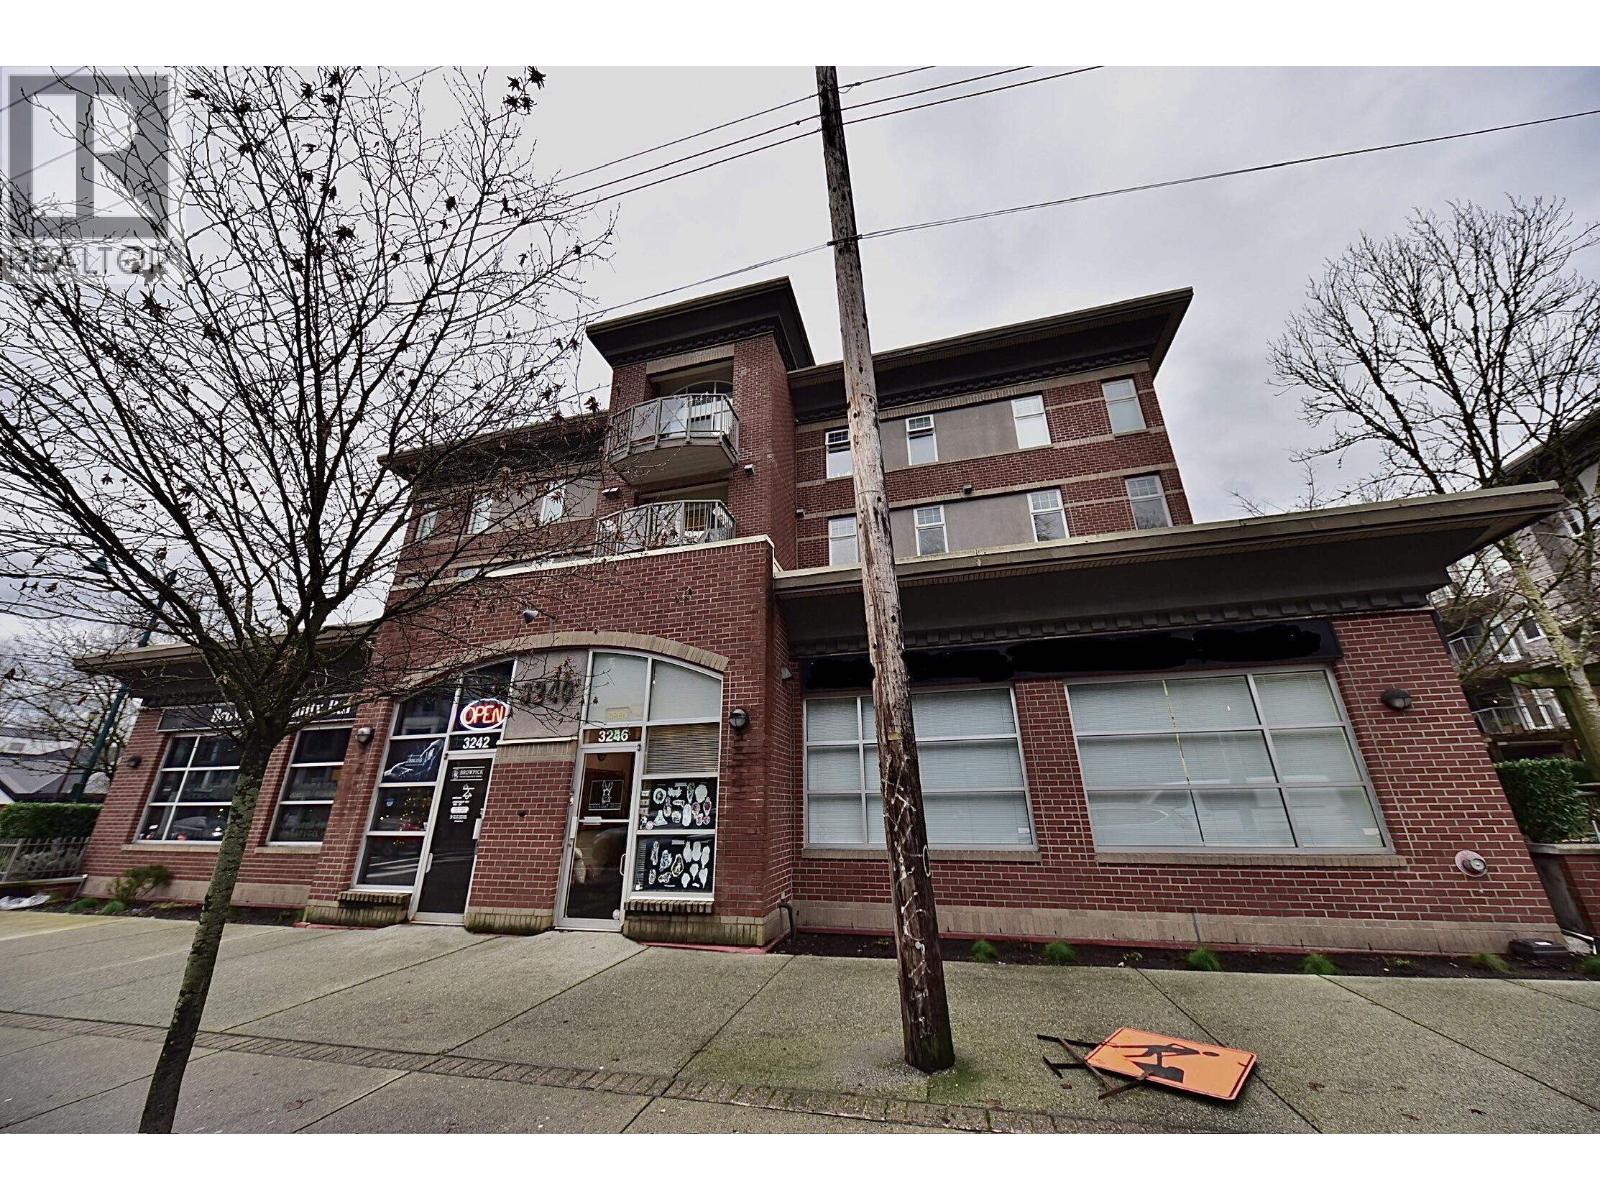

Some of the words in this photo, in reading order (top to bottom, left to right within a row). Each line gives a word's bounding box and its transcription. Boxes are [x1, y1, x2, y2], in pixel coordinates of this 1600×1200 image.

[463, 703, 504, 725] OPEN
[462, 736, 490, 749] 3242
[598, 729, 629, 743] 3246
